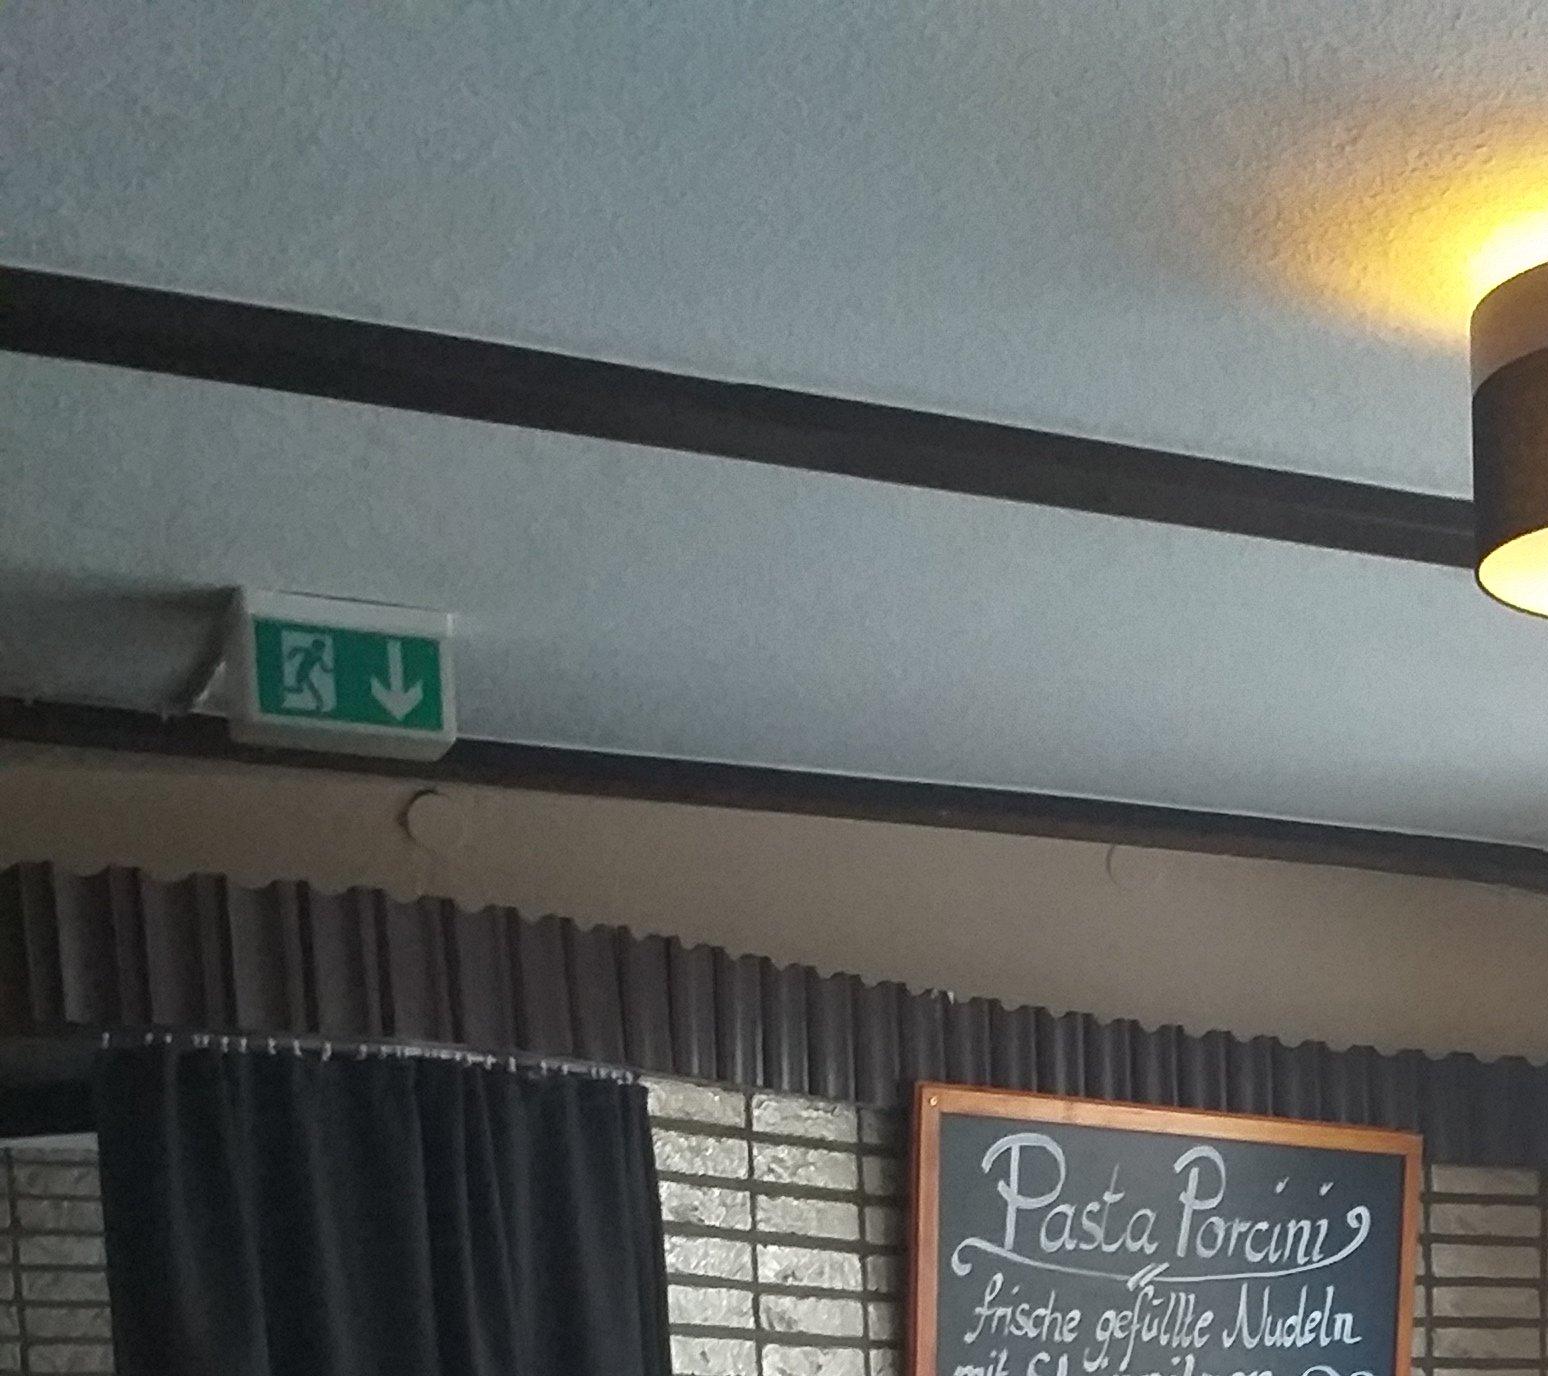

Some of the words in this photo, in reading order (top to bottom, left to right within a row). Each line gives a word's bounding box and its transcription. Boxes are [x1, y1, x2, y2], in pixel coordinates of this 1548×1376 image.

[981, 1132, 1159, 1252] Pasta
[1174, 1145, 1334, 1265] Porcini
[963, 1272, 1081, 1344] frische
[1222, 1282, 1362, 1349] Nudeln
